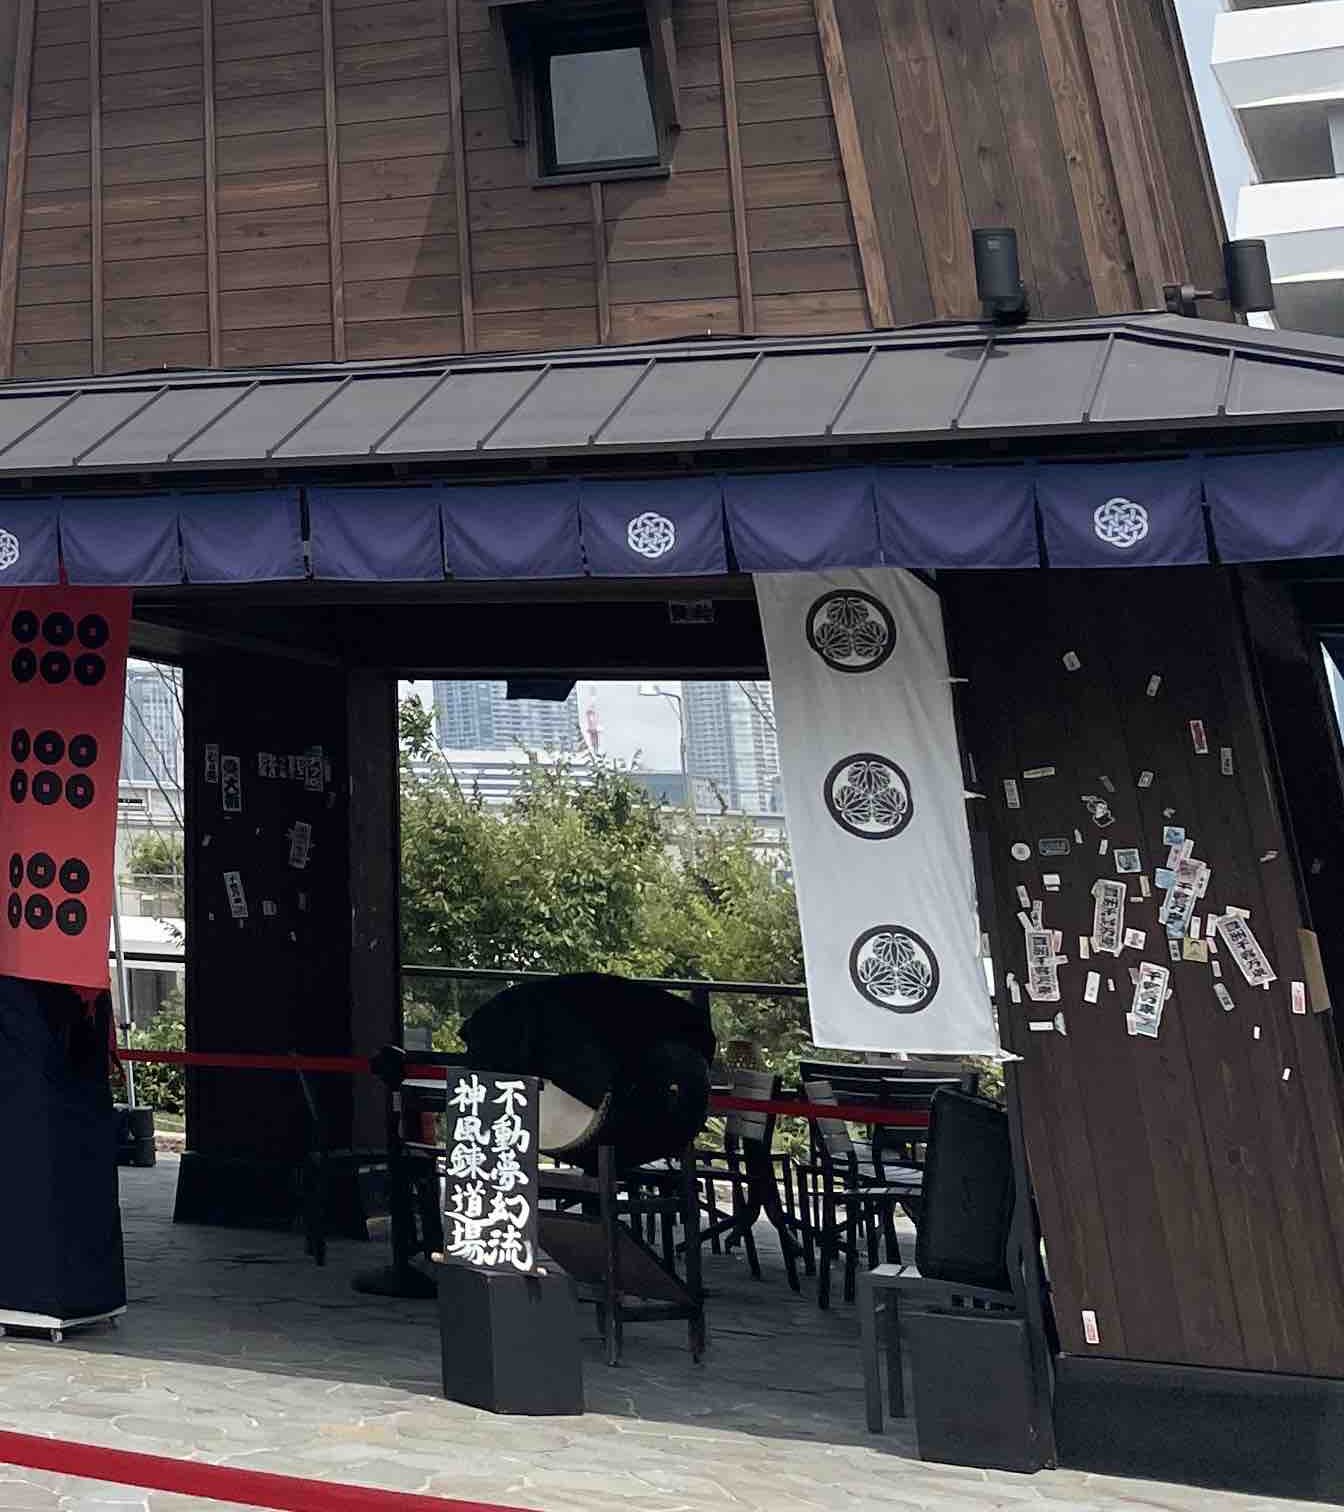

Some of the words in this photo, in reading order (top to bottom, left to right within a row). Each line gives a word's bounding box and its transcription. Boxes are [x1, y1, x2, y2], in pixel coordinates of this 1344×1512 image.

[483, 1080, 533, 1271] 不動夢幻流
